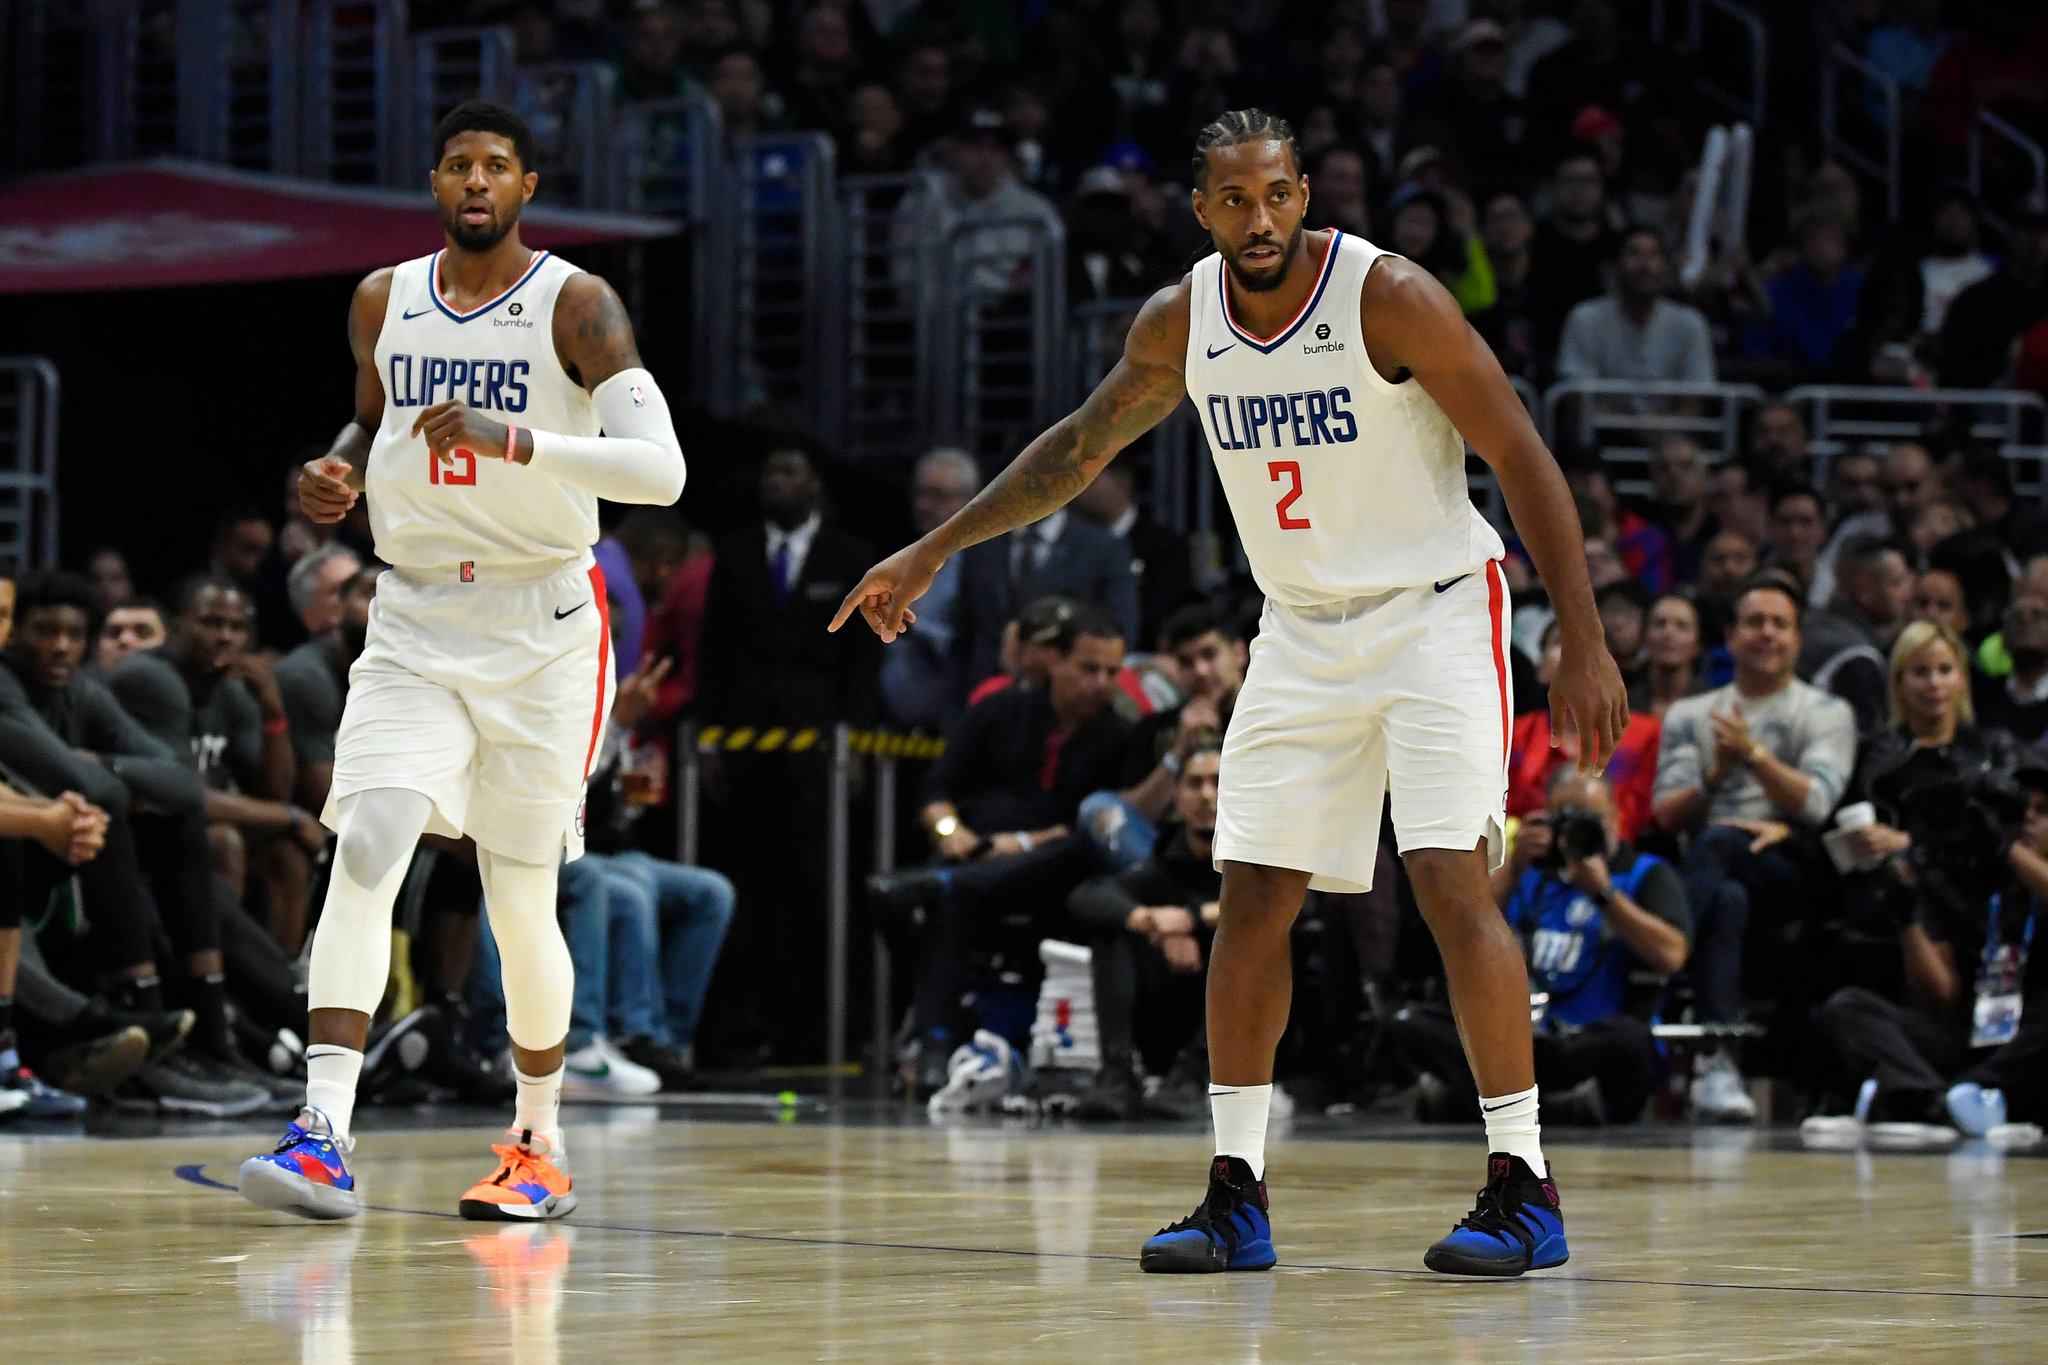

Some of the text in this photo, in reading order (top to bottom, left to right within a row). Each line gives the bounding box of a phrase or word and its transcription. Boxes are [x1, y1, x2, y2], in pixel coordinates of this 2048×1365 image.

[493, 318, 533, 328] bumble
[1304, 342, 1344, 354] bumble
[389, 353, 530, 413] CLIPPERS
[1207, 386, 1358, 450] CLIPPERS
[1268, 461, 1311, 529] 2
